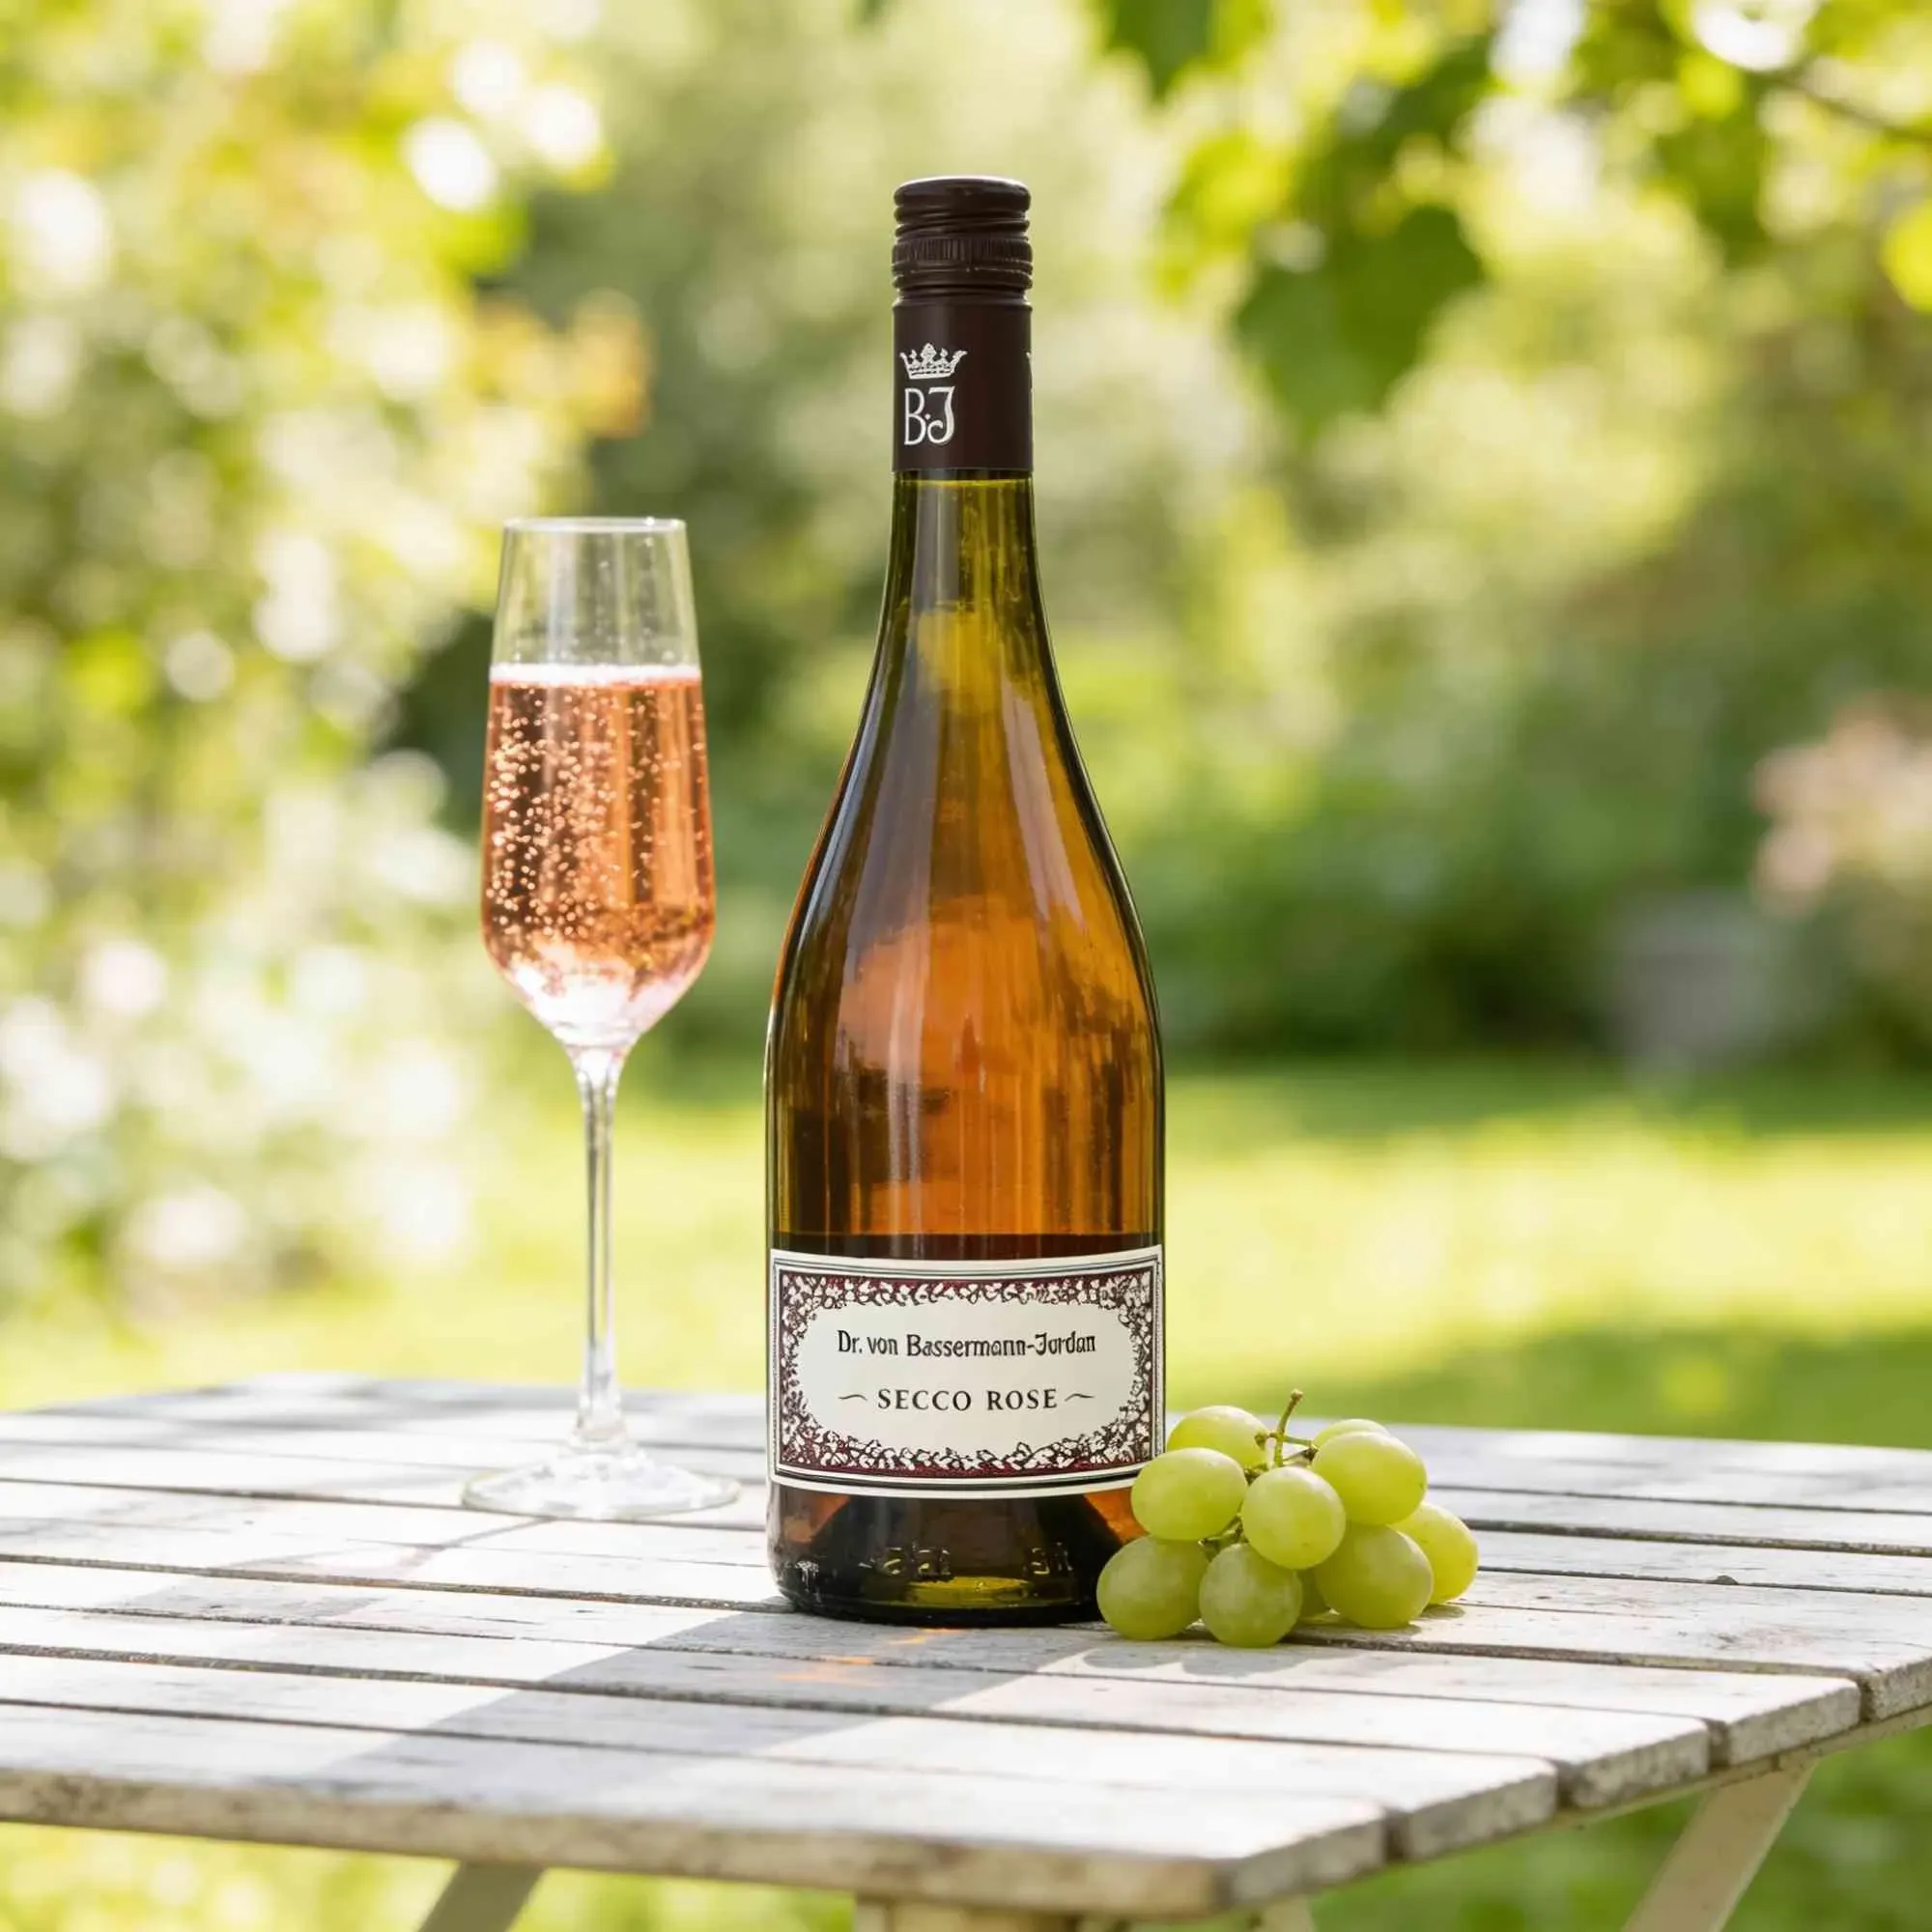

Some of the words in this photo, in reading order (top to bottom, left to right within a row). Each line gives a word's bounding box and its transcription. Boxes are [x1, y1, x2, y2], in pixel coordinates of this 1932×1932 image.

[838, 1329, 863, 1353] Dr.
[867, 1336, 898, 1356] von
[906, 1330, 1096, 1357] Bassermann-Jordan
[877, 1388, 972, 1411] SECCO
[987, 1388, 1058, 1411] ROSE
